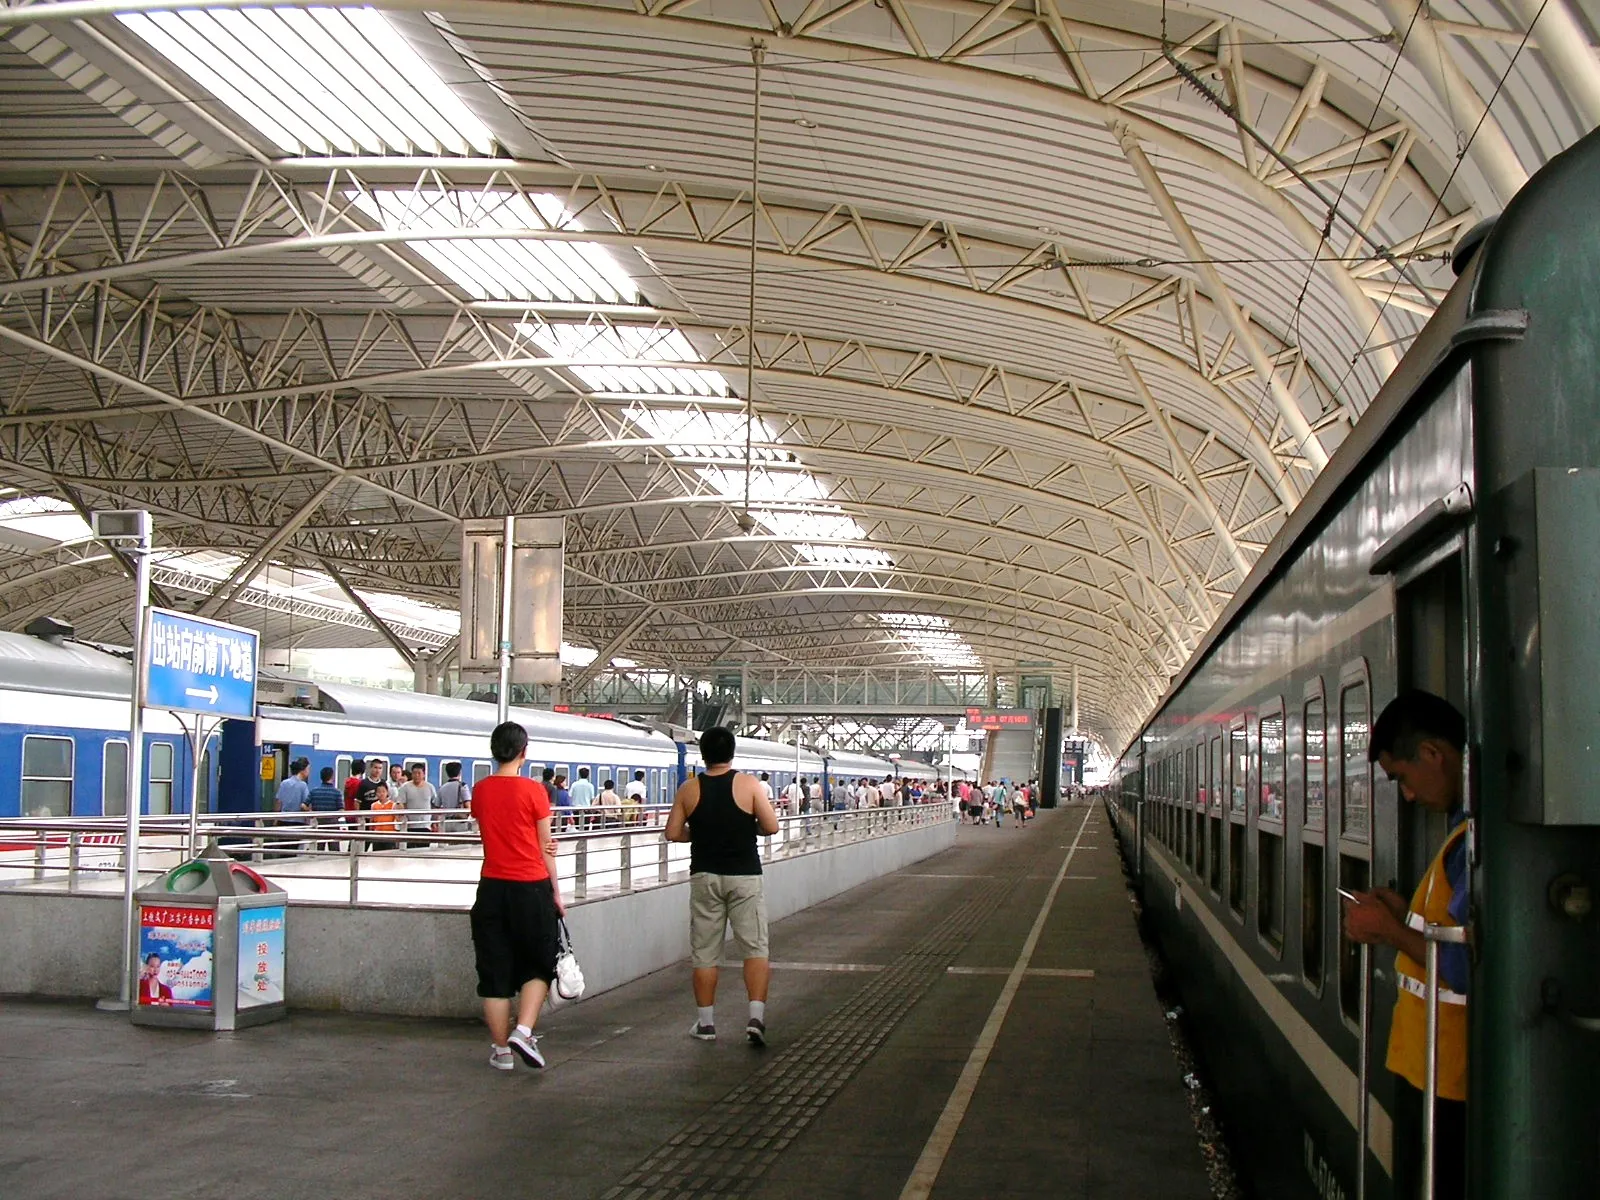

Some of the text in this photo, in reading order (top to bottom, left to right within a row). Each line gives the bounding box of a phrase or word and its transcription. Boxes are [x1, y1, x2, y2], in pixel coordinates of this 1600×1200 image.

[152, 622, 253, 682] 出站向前请下地道
